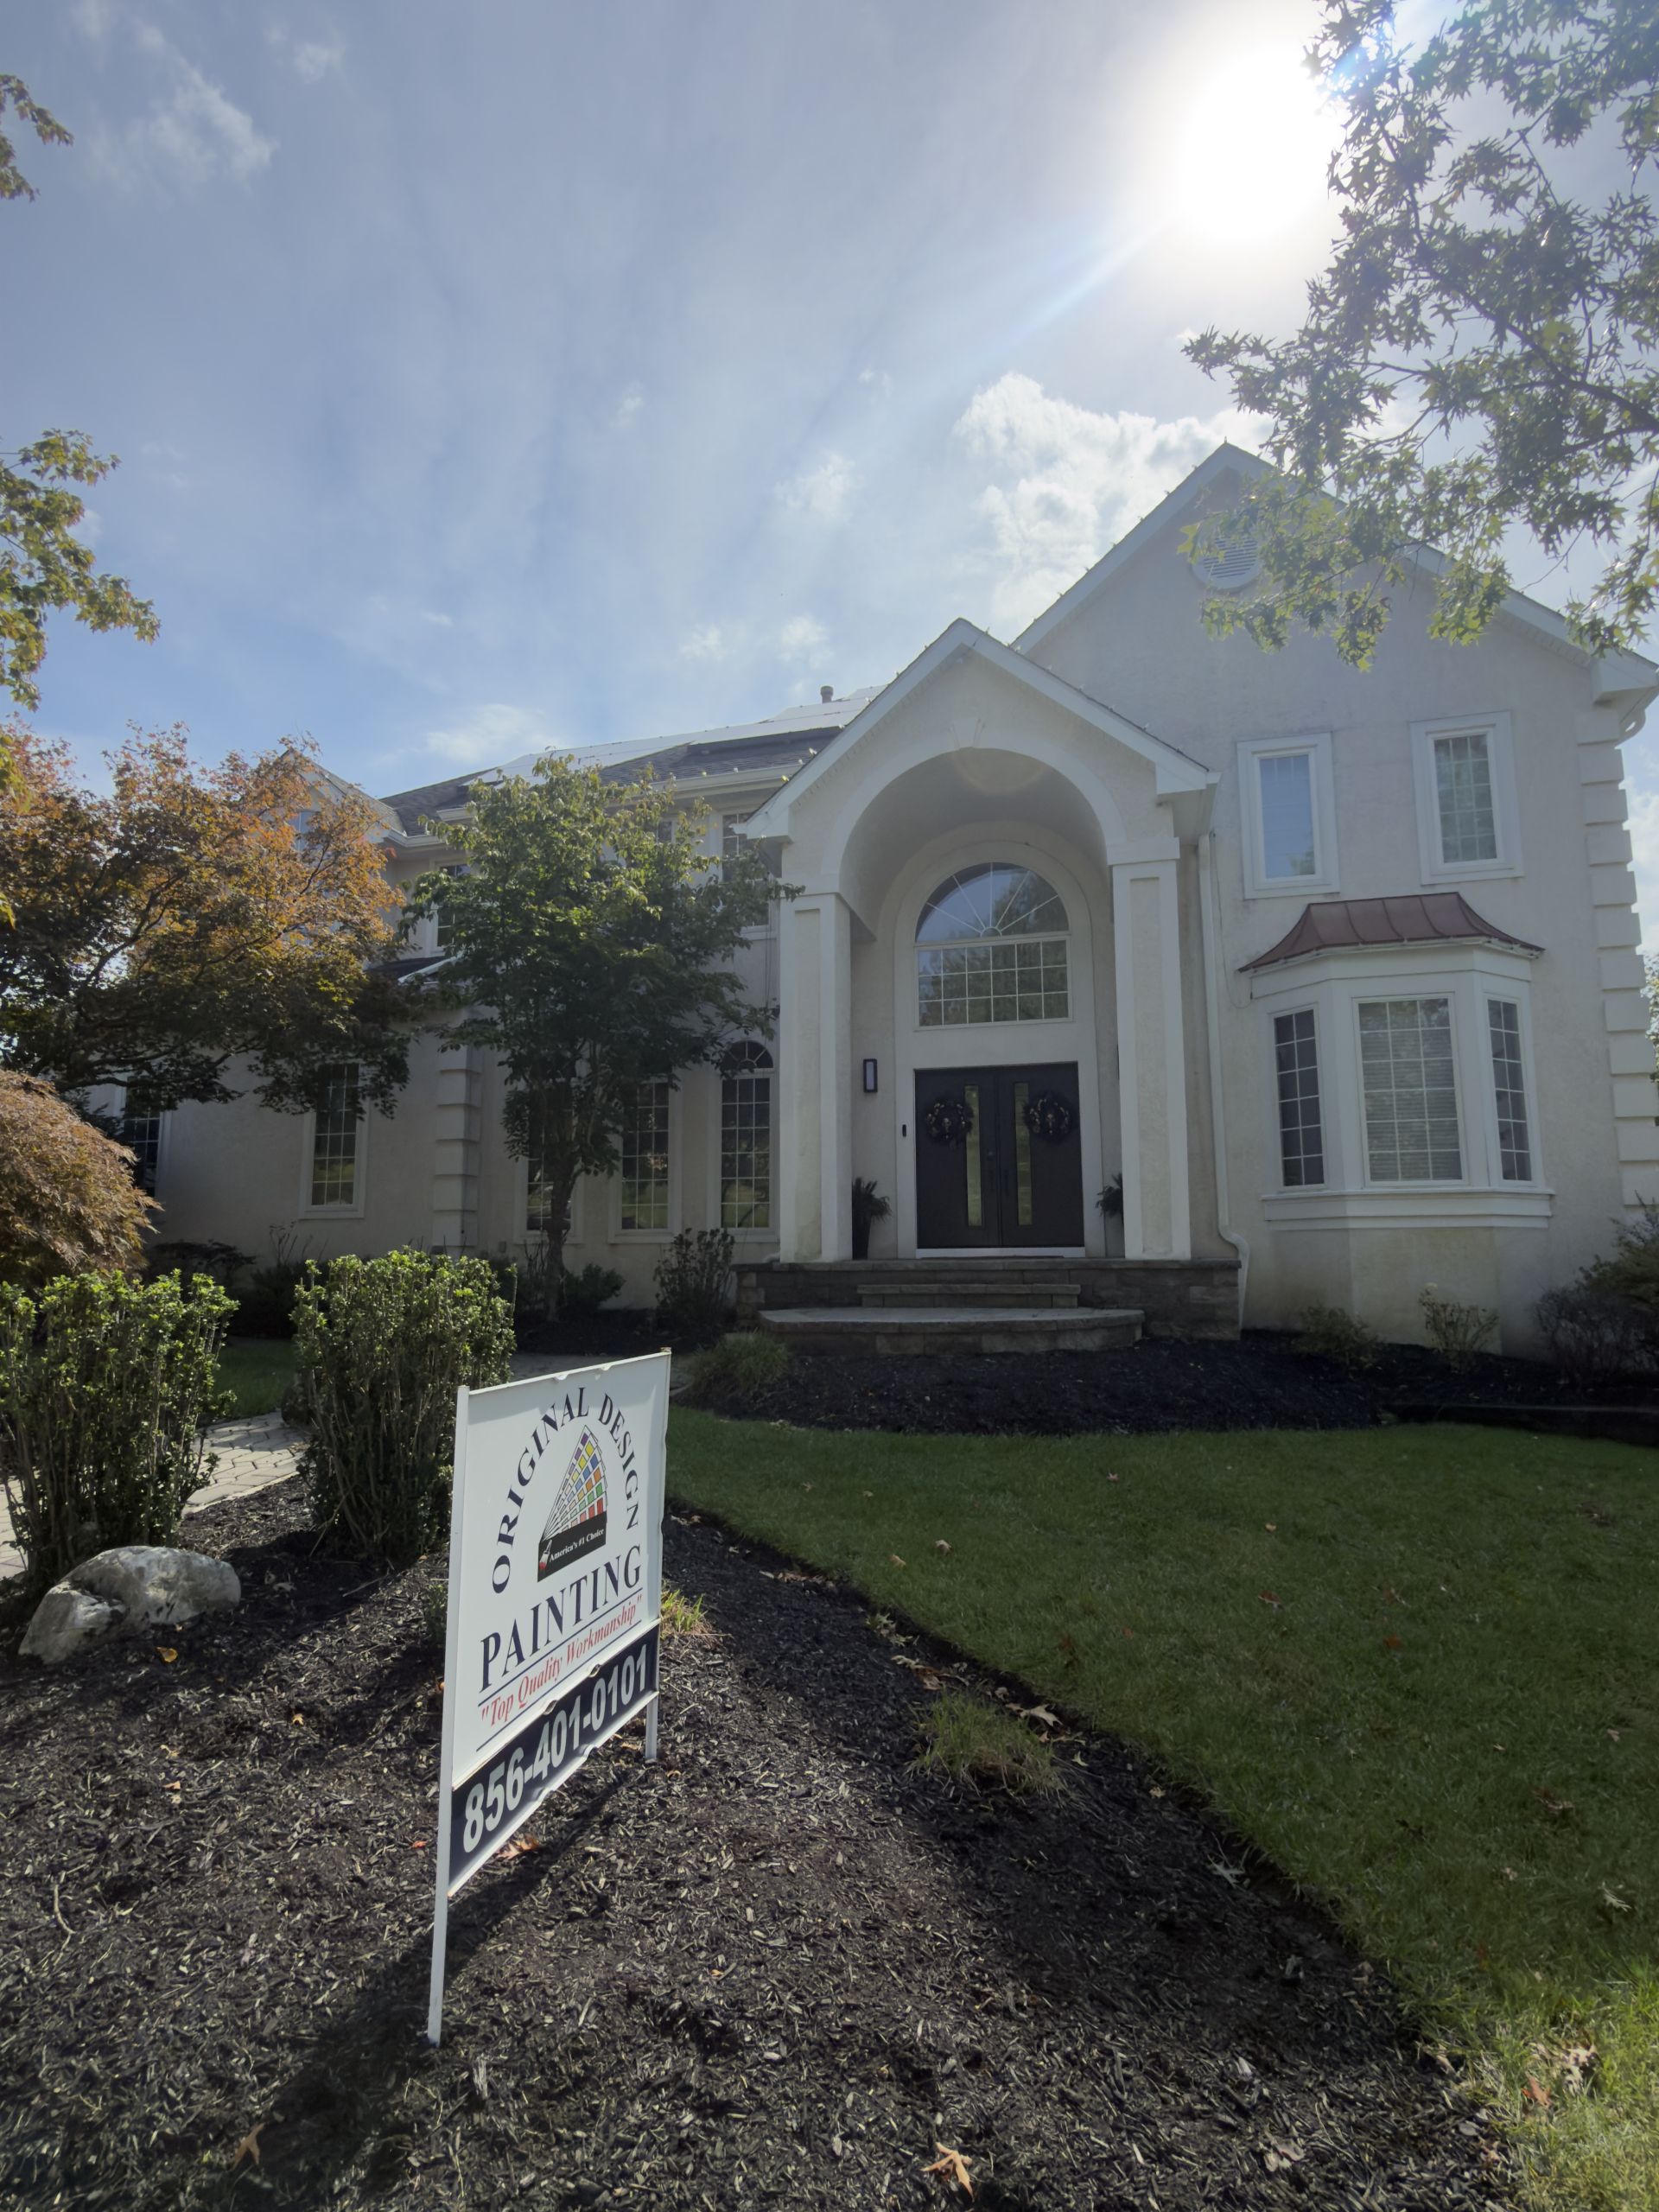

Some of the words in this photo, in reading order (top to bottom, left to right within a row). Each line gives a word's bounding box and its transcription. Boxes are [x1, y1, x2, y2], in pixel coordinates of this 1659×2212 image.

[493, 1387, 589, 1593] ORIGINAL
[598, 1393, 639, 1530] DESIGN
[550, 1541, 578, 1562] America's
[578, 1536, 585, 1546] #1
[586, 1529, 604, 1541] Choice
[480, 1544, 641, 1694] PAINTING
[481, 1694, 514, 1728] "Top
[518, 1656, 563, 1709] Quality
[566, 1593, 642, 1665] Workmanship"
[463, 1643, 647, 1853] 856-401-0101
